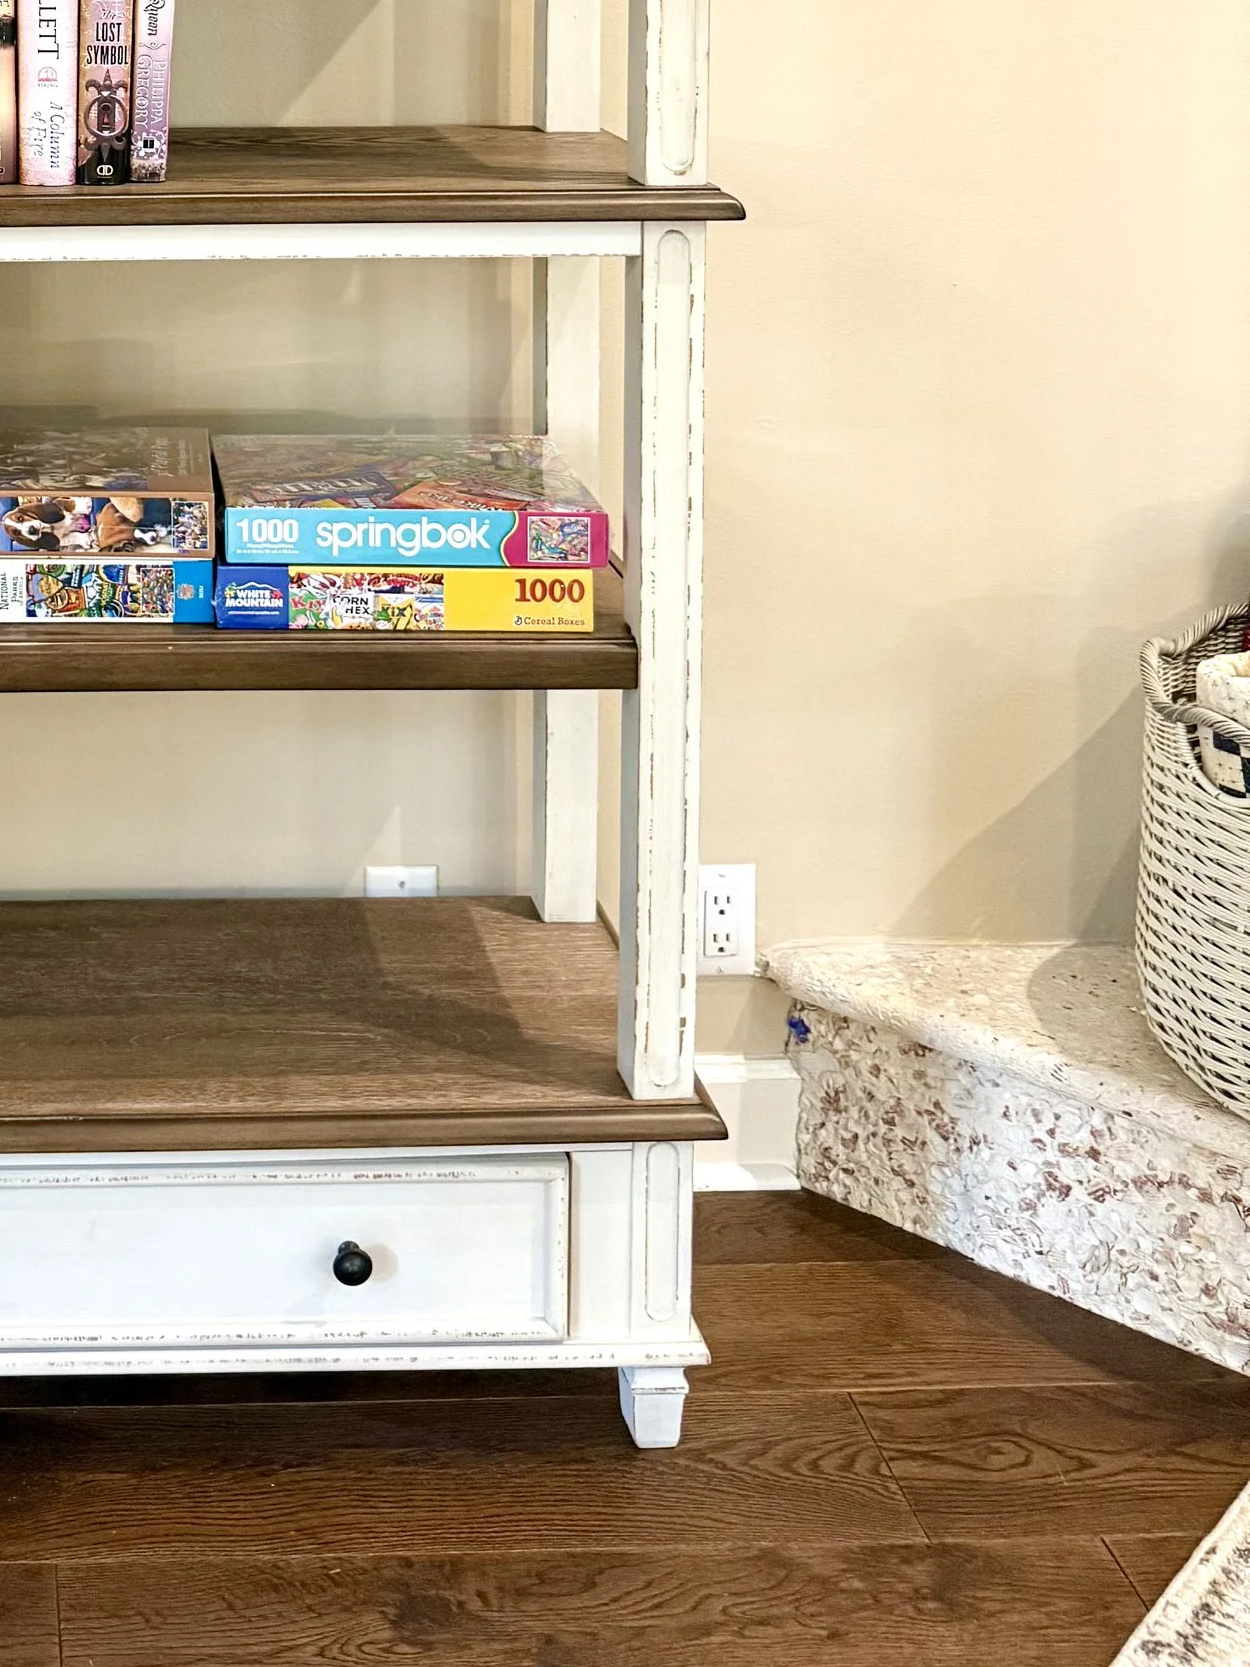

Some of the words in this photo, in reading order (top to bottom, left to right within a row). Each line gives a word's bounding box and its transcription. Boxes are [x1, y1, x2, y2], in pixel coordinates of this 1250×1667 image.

[95, 22, 122, 43] LOST
[86, 45, 129, 66] SYMBOL
[135, 54, 153, 128] GREGORY
[151, 59, 167, 125] PHILIPPA
[236, 518, 299, 543] 1000
[315, 516, 490, 557] springbok
[0, 570, 9, 610] NATIONAL
[236, 589, 271, 599] WHITE
[515, 578, 585, 603] 1000
[225, 598, 283, 608] MOUNTAIN
[524, 616, 555, 626] Cereal
[557, 617, 585, 626] Boxes
